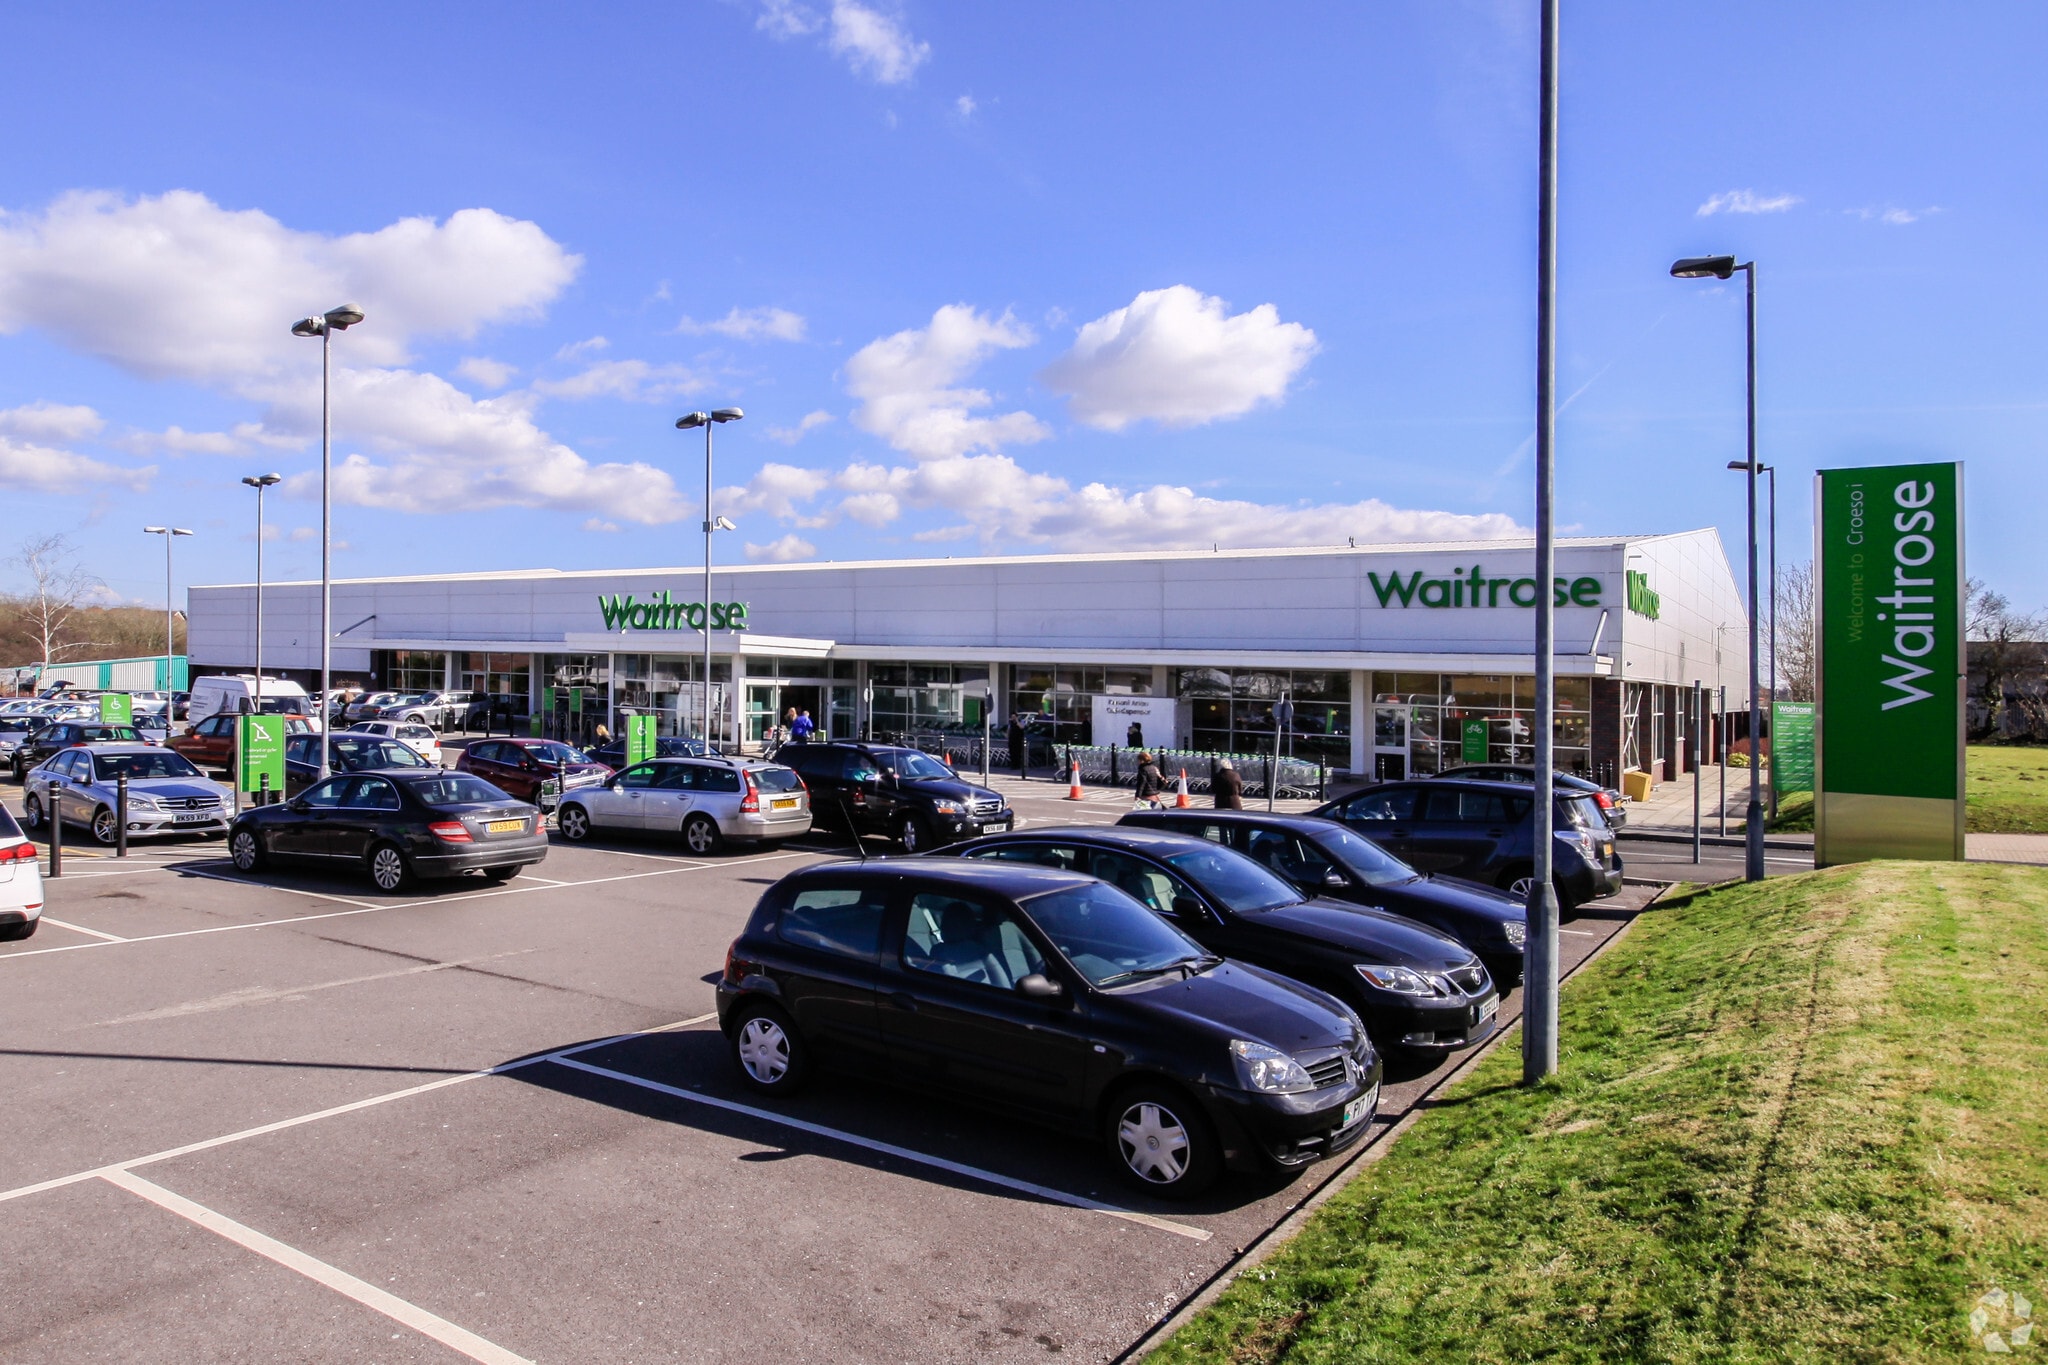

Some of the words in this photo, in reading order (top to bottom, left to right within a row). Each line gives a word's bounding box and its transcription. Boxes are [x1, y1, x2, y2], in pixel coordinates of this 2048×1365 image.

[1846, 490, 1864, 546] Croeso
[1847, 553, 1864, 569] to
[1366, 564, 1602, 609] Waitrose
[1847, 573, 1864, 643] Welcome
[1875, 480, 1935, 712] Waitrose
[598, 590, 748, 631] Waitrose
[1777, 704, 1812, 713] Waitrose
